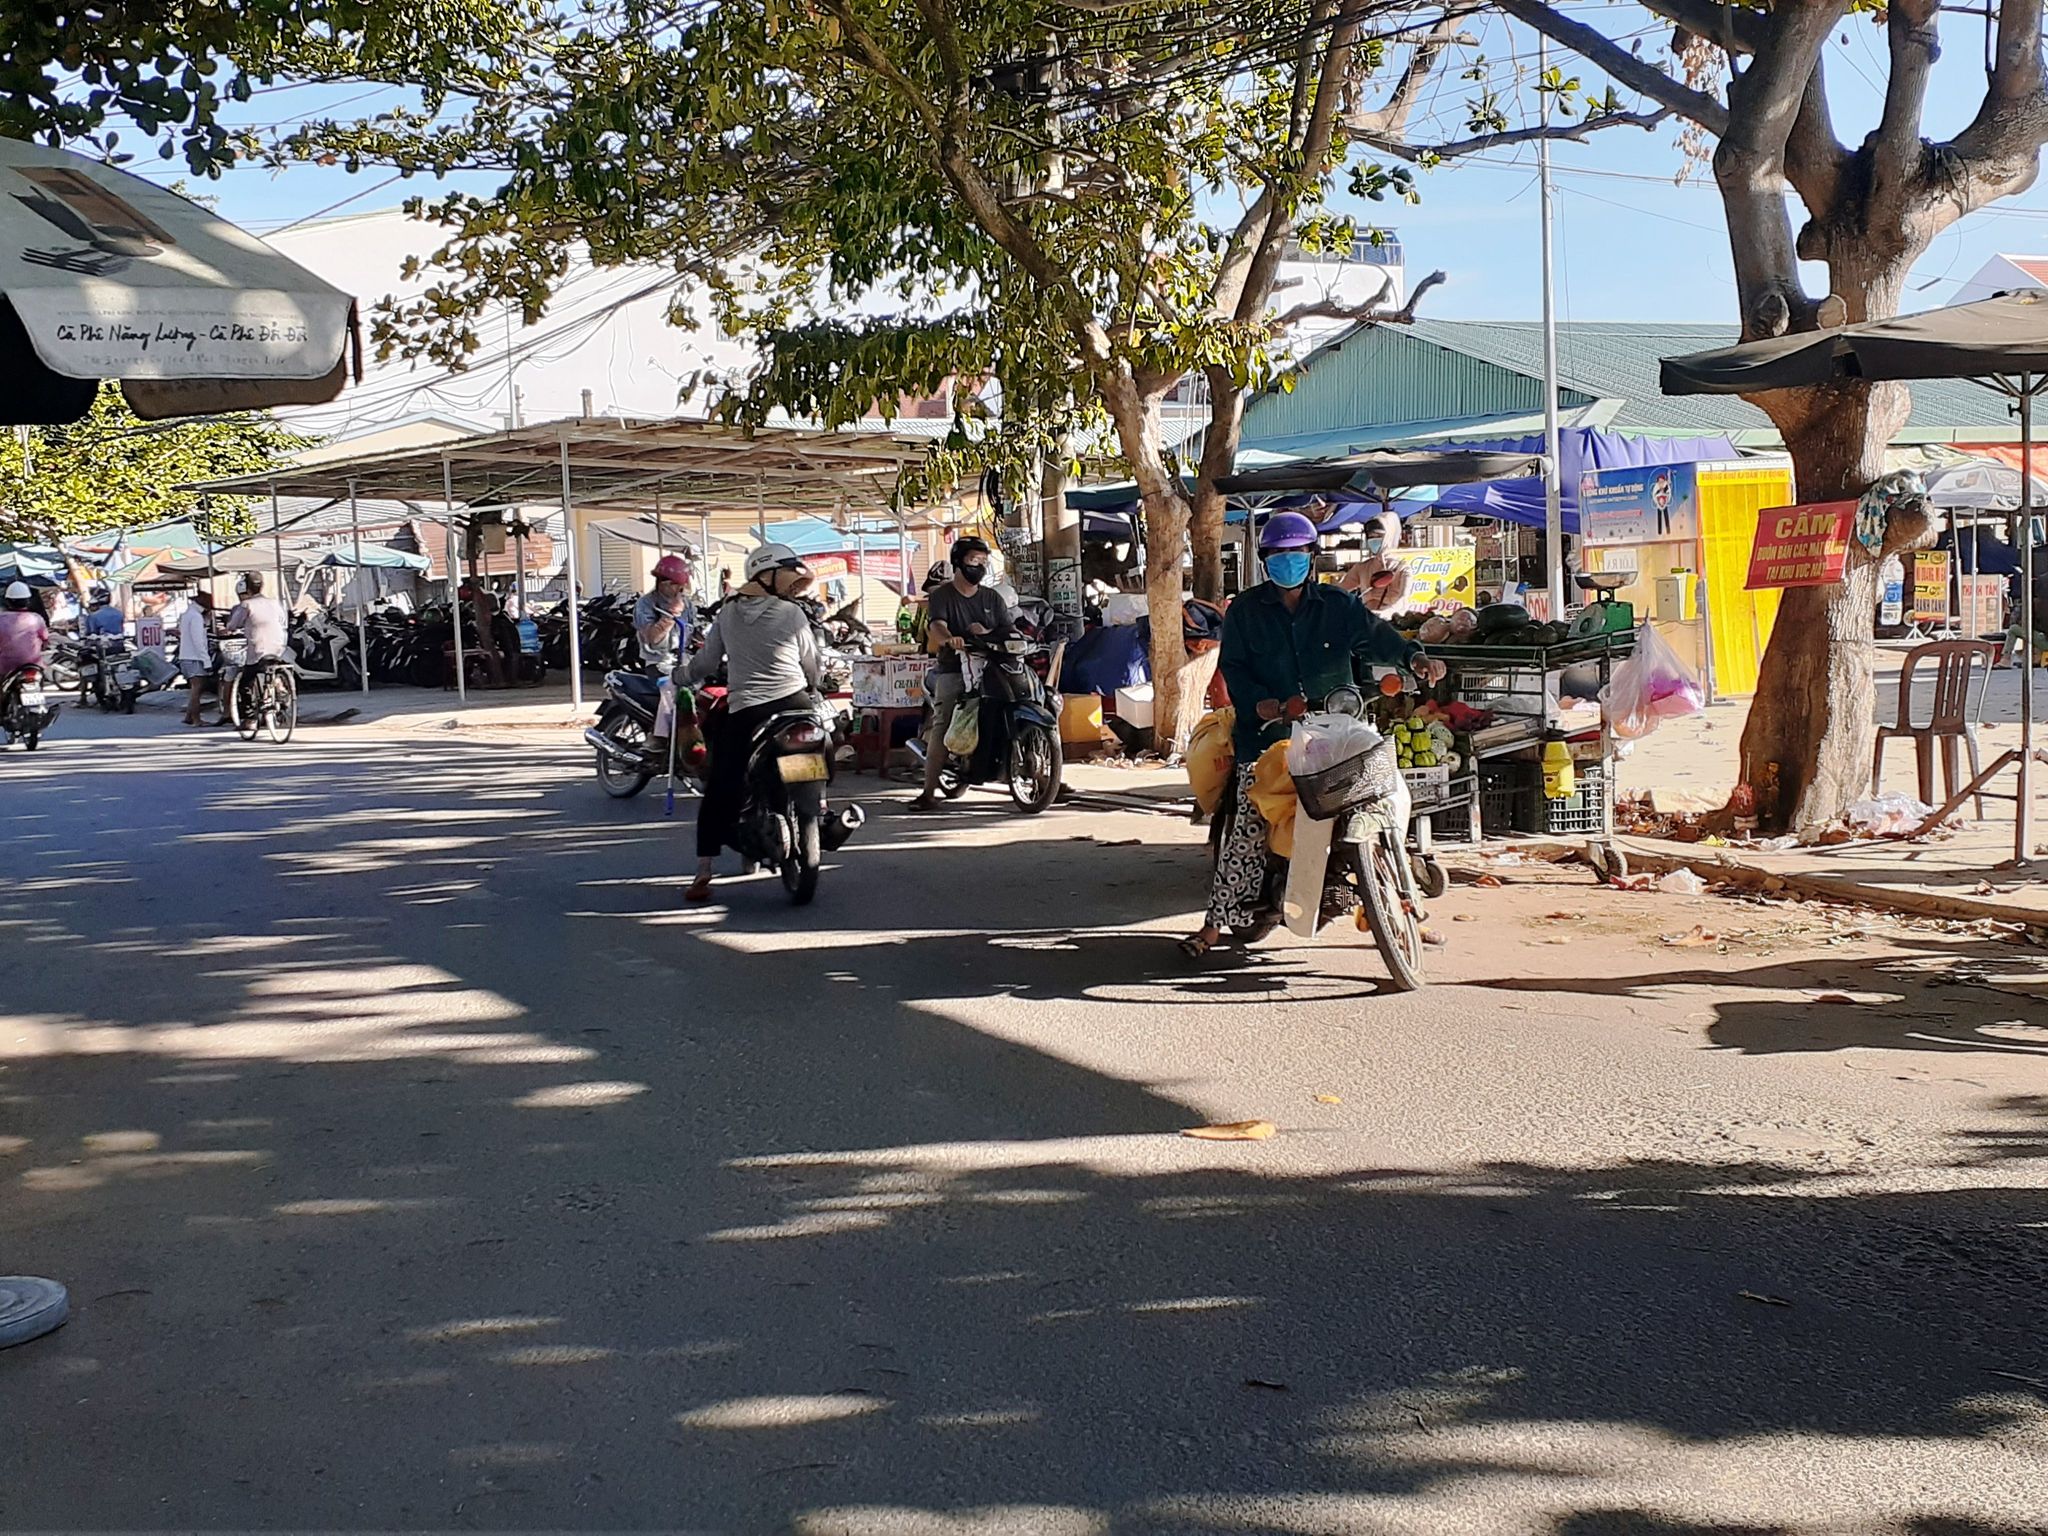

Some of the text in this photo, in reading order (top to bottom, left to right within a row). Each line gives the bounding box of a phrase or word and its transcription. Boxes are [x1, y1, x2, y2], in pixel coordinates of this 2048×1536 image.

[57, 325, 76, 341] Cà
[80, 324, 104, 341] Phê
[109, 324, 151, 351] Năng
[155, 322, 197, 352] Lượng
[210, 325, 227, 341] Cà
[231, 323, 255, 341] Phê
[1775, 507, 1837, 539] CẤM
[1411, 557, 1451, 575] Trang
